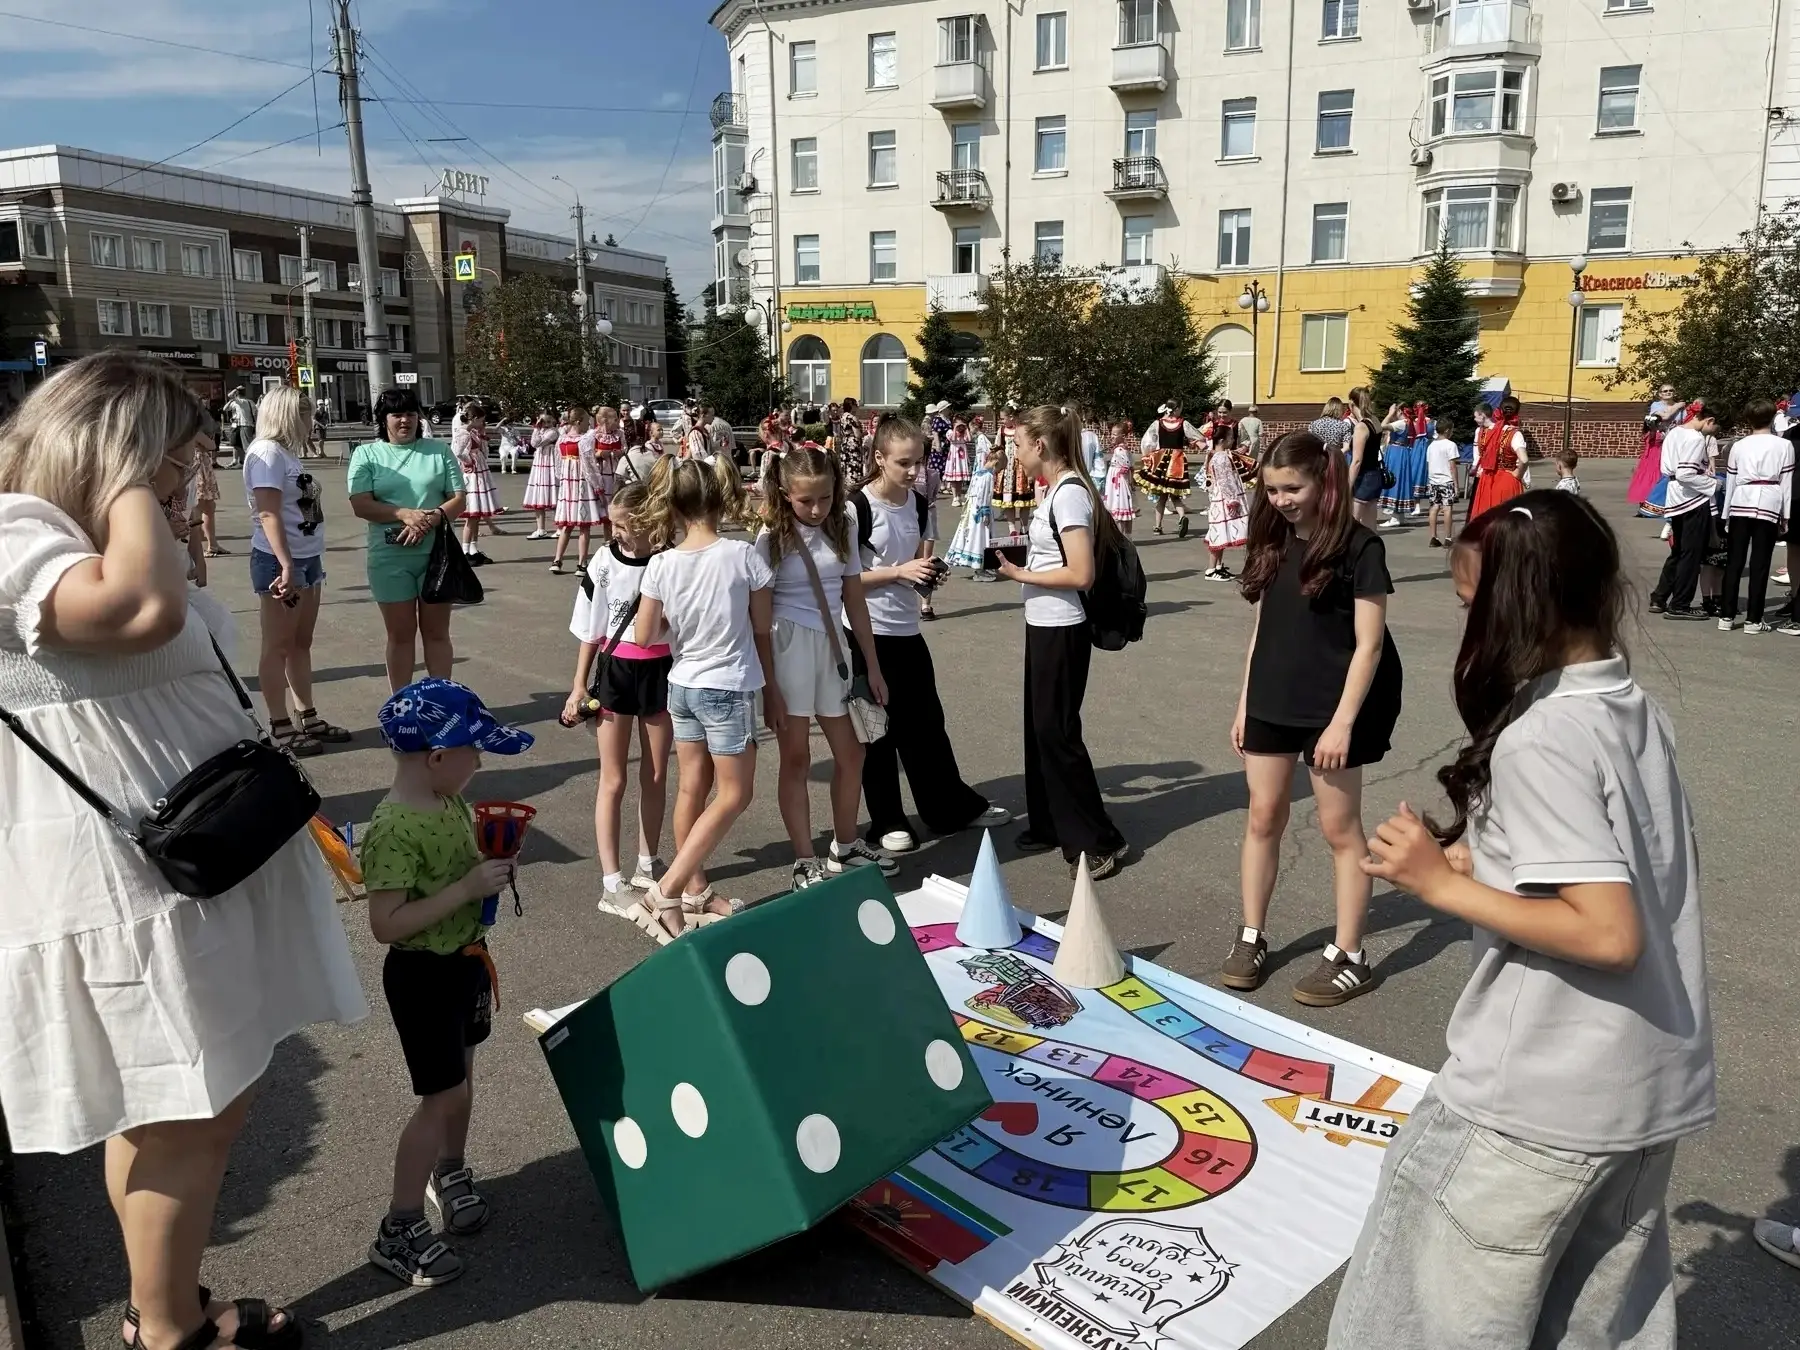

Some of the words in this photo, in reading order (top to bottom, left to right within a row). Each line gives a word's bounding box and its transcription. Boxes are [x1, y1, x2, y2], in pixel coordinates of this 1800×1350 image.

[254, 357, 290, 369] FOOD
[398, 374, 415, 382] СТОП
[435, 712, 462, 740] Football
[1118, 989, 1143, 999] 4
[1155, 1015, 1181, 1026] 3
[974, 1028, 1014, 1045] 12
[1204, 1041, 1232, 1053] 2
[1047, 1048, 1088, 1065] 13
[1117, 1066, 1162, 1089] 14
[1279, 1067, 1304, 1081] 1
[1182, 1102, 1226, 1126] 15
[1305, 1107, 1400, 1138] СТАРТ
[1043, 1124, 1087, 1146] Я
[1183, 1148, 1235, 1176] 16
[1011, 1169, 1062, 1192] 18
[1116, 1178, 1170, 1204] 17
[1105, 1245, 1173, 1284] город
[1064, 1260, 1182, 1315] Лучший
